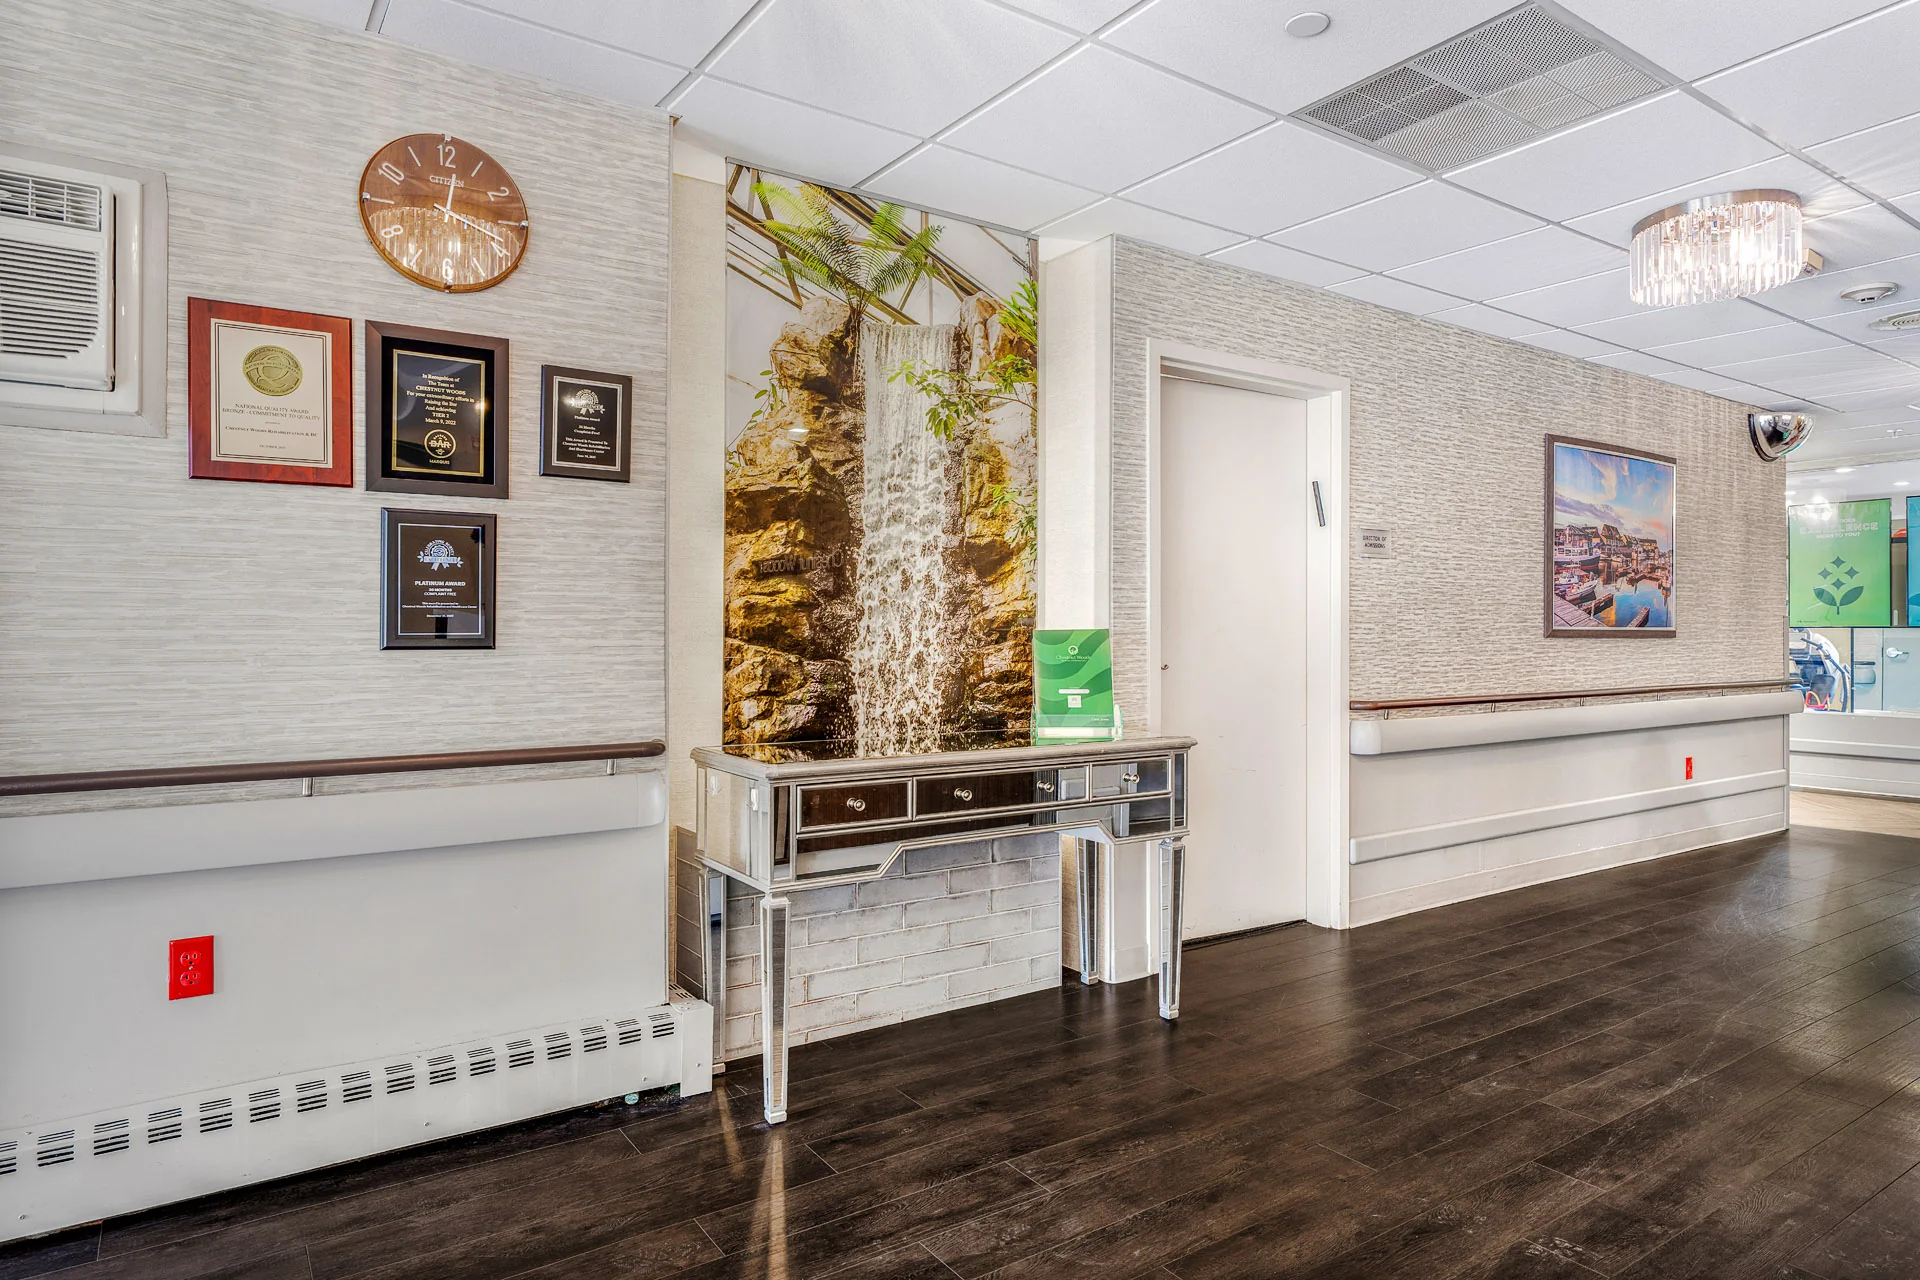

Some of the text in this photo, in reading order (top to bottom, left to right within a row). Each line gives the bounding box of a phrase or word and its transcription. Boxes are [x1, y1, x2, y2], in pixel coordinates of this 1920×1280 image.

[437, 144, 456, 168] 12
[378, 162, 404, 185] 10
[429, 176, 464, 187] CITIZEN
[487, 187, 510, 201] 2
[381, 225, 403, 239] 8
[490, 240, 510, 258] 4
[442, 258, 453, 279] 6
[428, 374, 454, 382] Recognition
[416, 385, 445, 393] CHESTNUT
[428, 440, 452, 448] BAR
